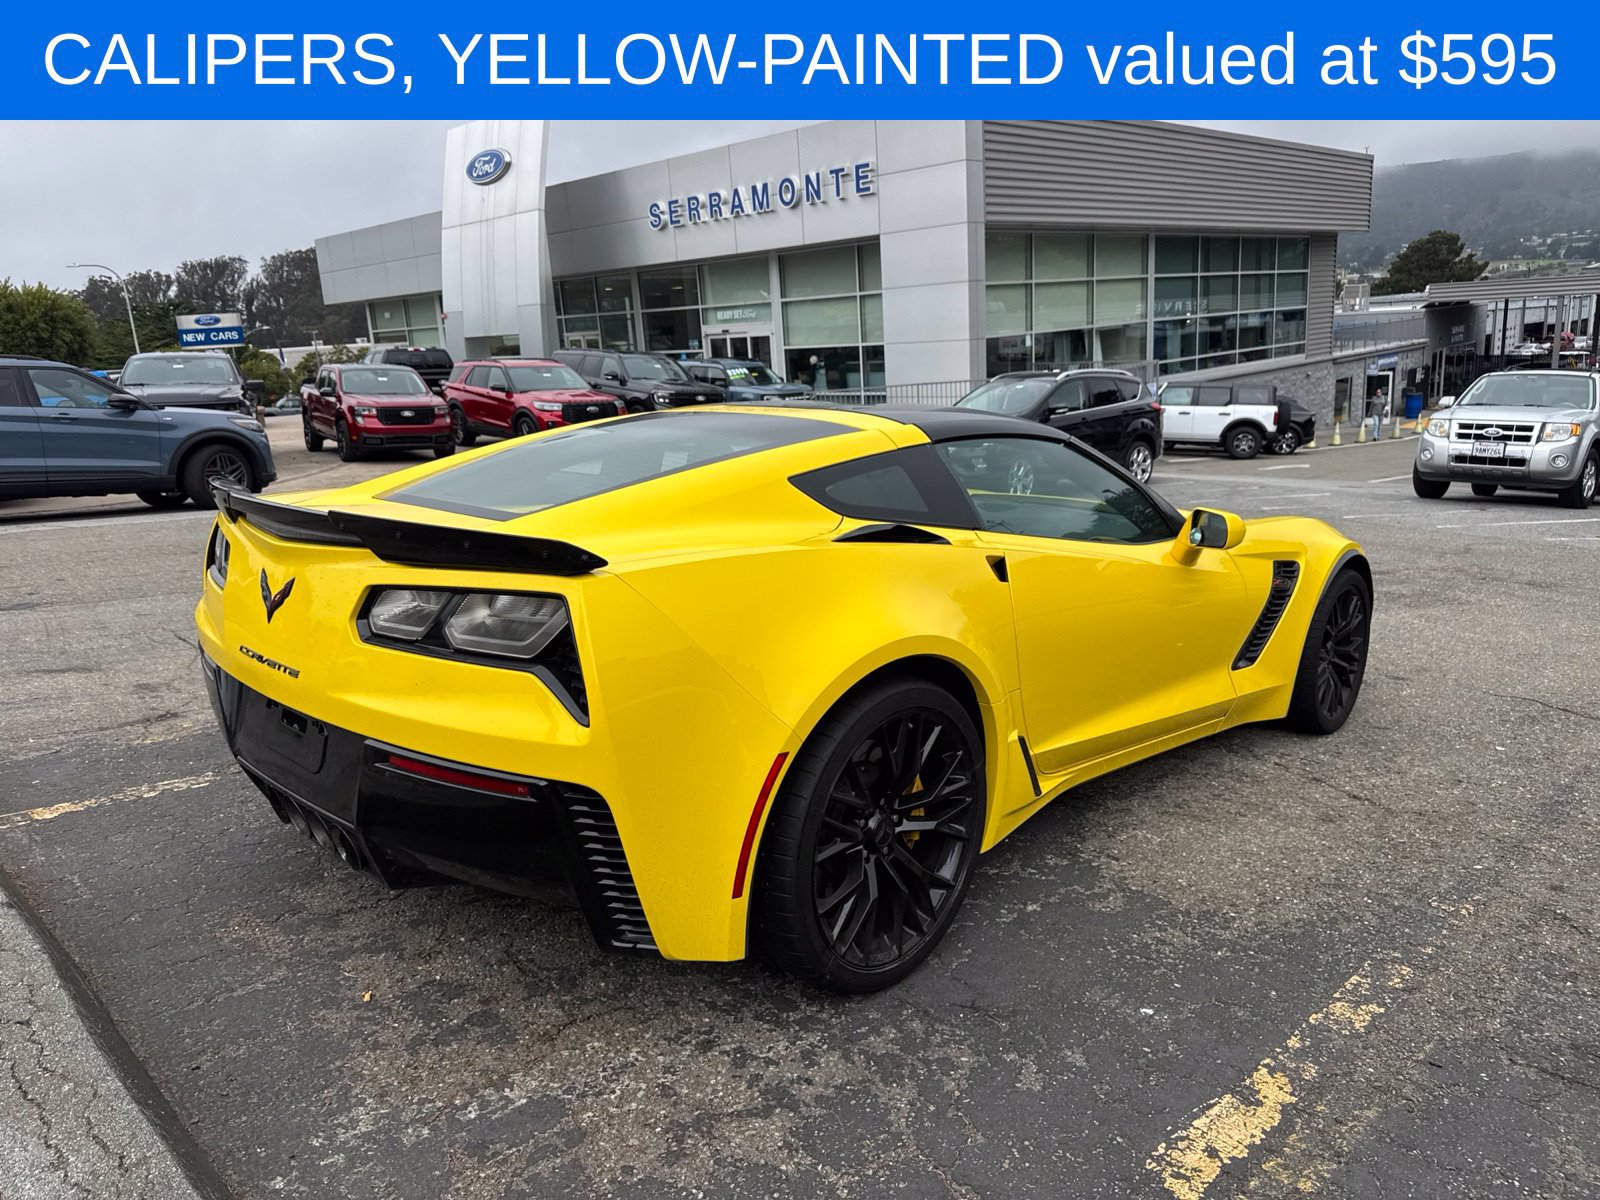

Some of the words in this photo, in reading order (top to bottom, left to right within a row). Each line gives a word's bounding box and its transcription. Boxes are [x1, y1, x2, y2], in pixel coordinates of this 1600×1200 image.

[472, 155, 496, 177] Ford
[649, 162, 873, 231] SERRAMONTE
[182, 333, 205, 342] NEW
[210, 330, 239, 341] CARS
[239, 645, 300, 679] CORVETTE
